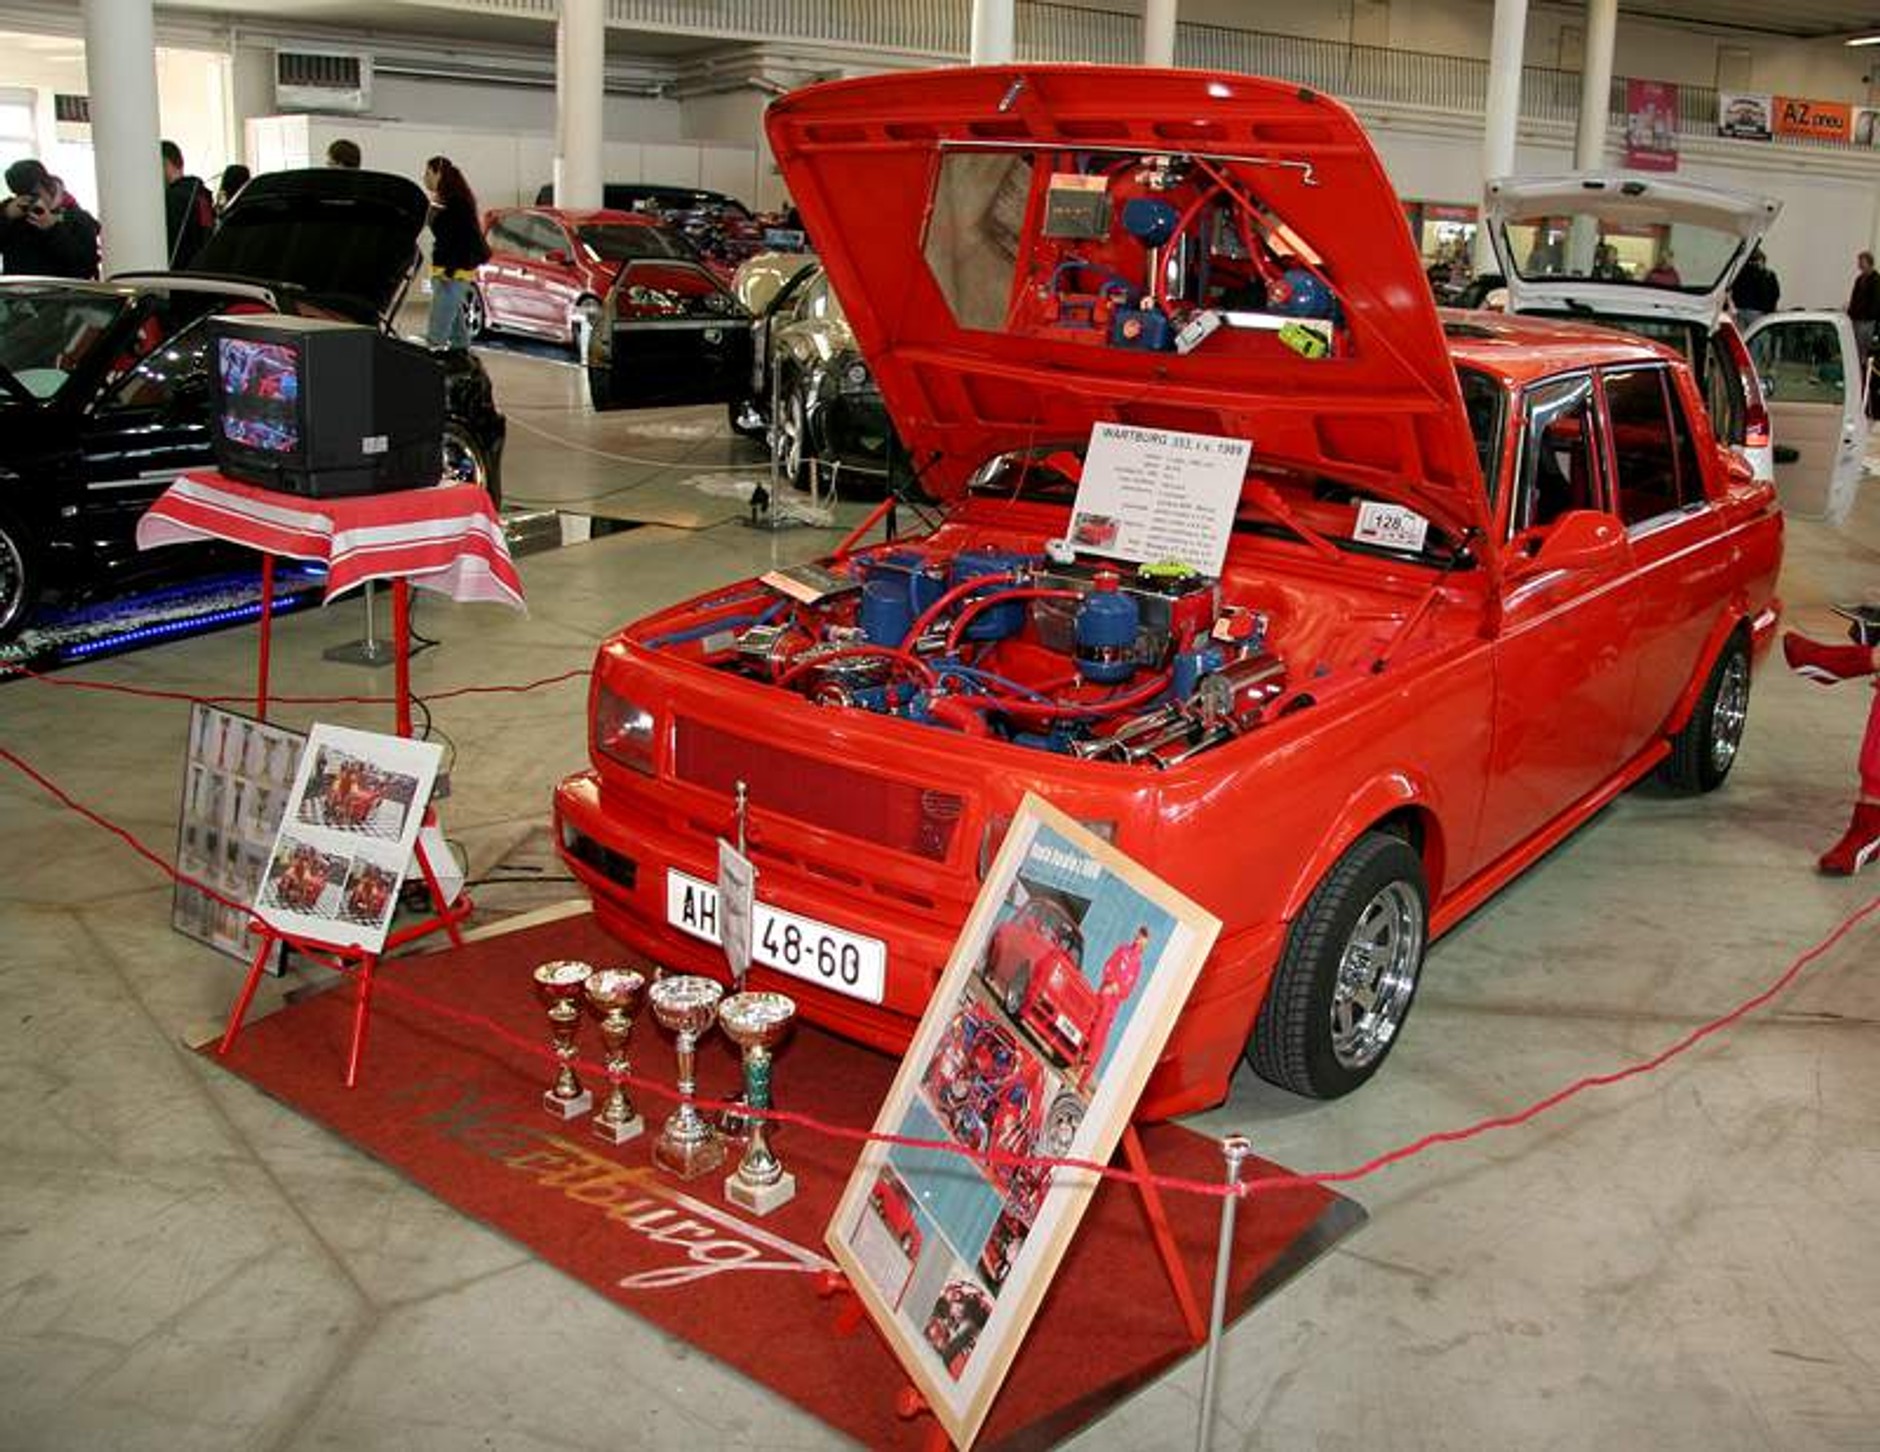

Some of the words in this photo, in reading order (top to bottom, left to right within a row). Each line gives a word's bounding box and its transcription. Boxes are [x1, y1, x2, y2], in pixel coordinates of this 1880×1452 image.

[1784, 103, 1809, 126] AZ
[1103, 428, 1167, 445] WARTBURG
[682, 885, 717, 935] AH
[761, 917, 860, 986] 48-60
